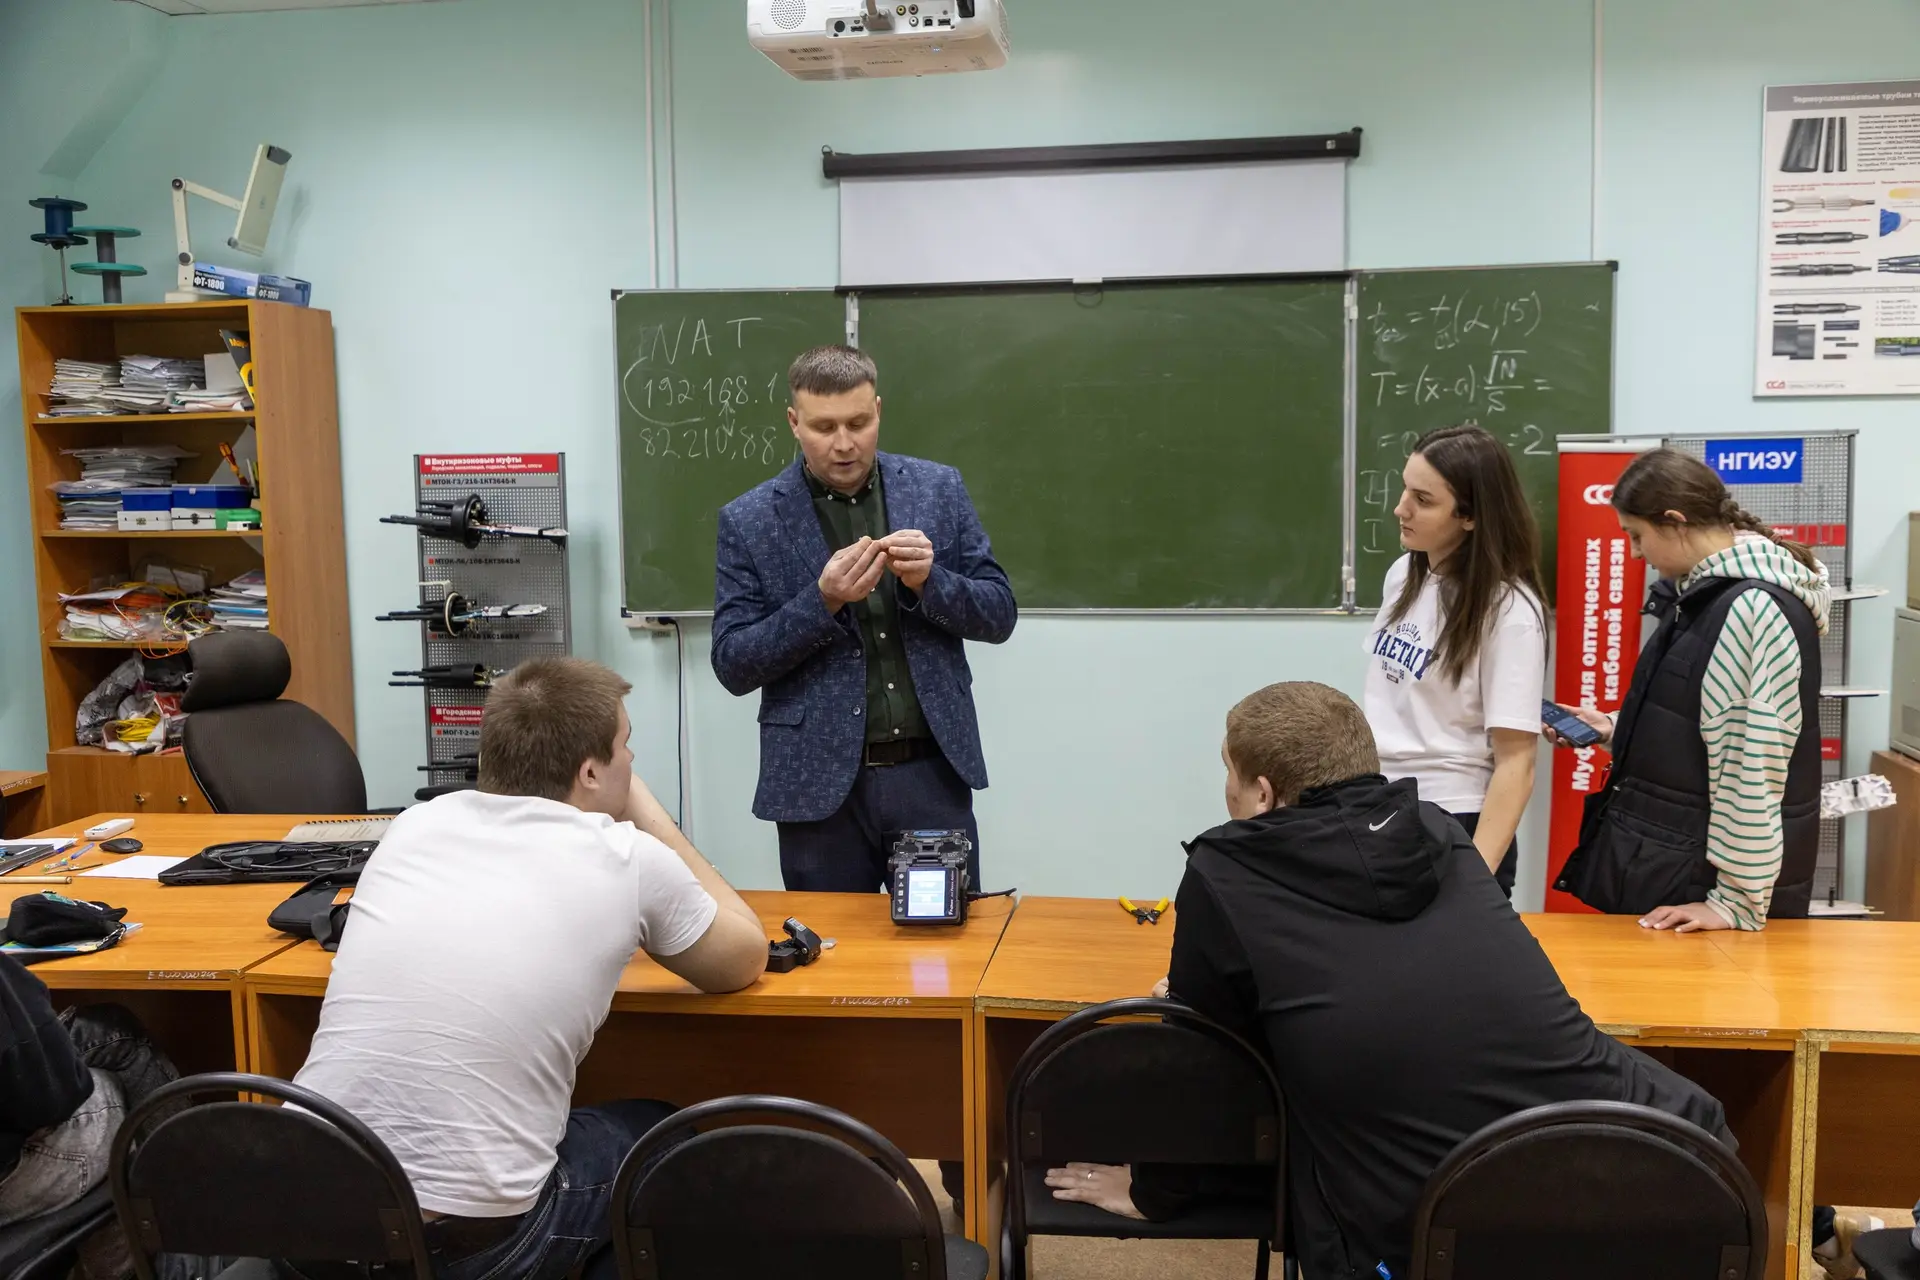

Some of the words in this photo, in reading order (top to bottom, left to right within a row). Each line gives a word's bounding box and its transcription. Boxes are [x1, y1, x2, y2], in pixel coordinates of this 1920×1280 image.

[194, 276, 224, 291] ФТ-1800
[496, 456, 522, 464] муфты
[1718, 450, 1798, 471] НГИЭУ
[1609, 538, 1625, 604] связи
[1582, 538, 1601, 667] оптических
[1396, 622, 1421, 643] HOLIDAY
[1603, 607, 1622, 701] кабелей
[1580, 671, 1597, 710] для
[1572, 745, 1595, 792] Муф
